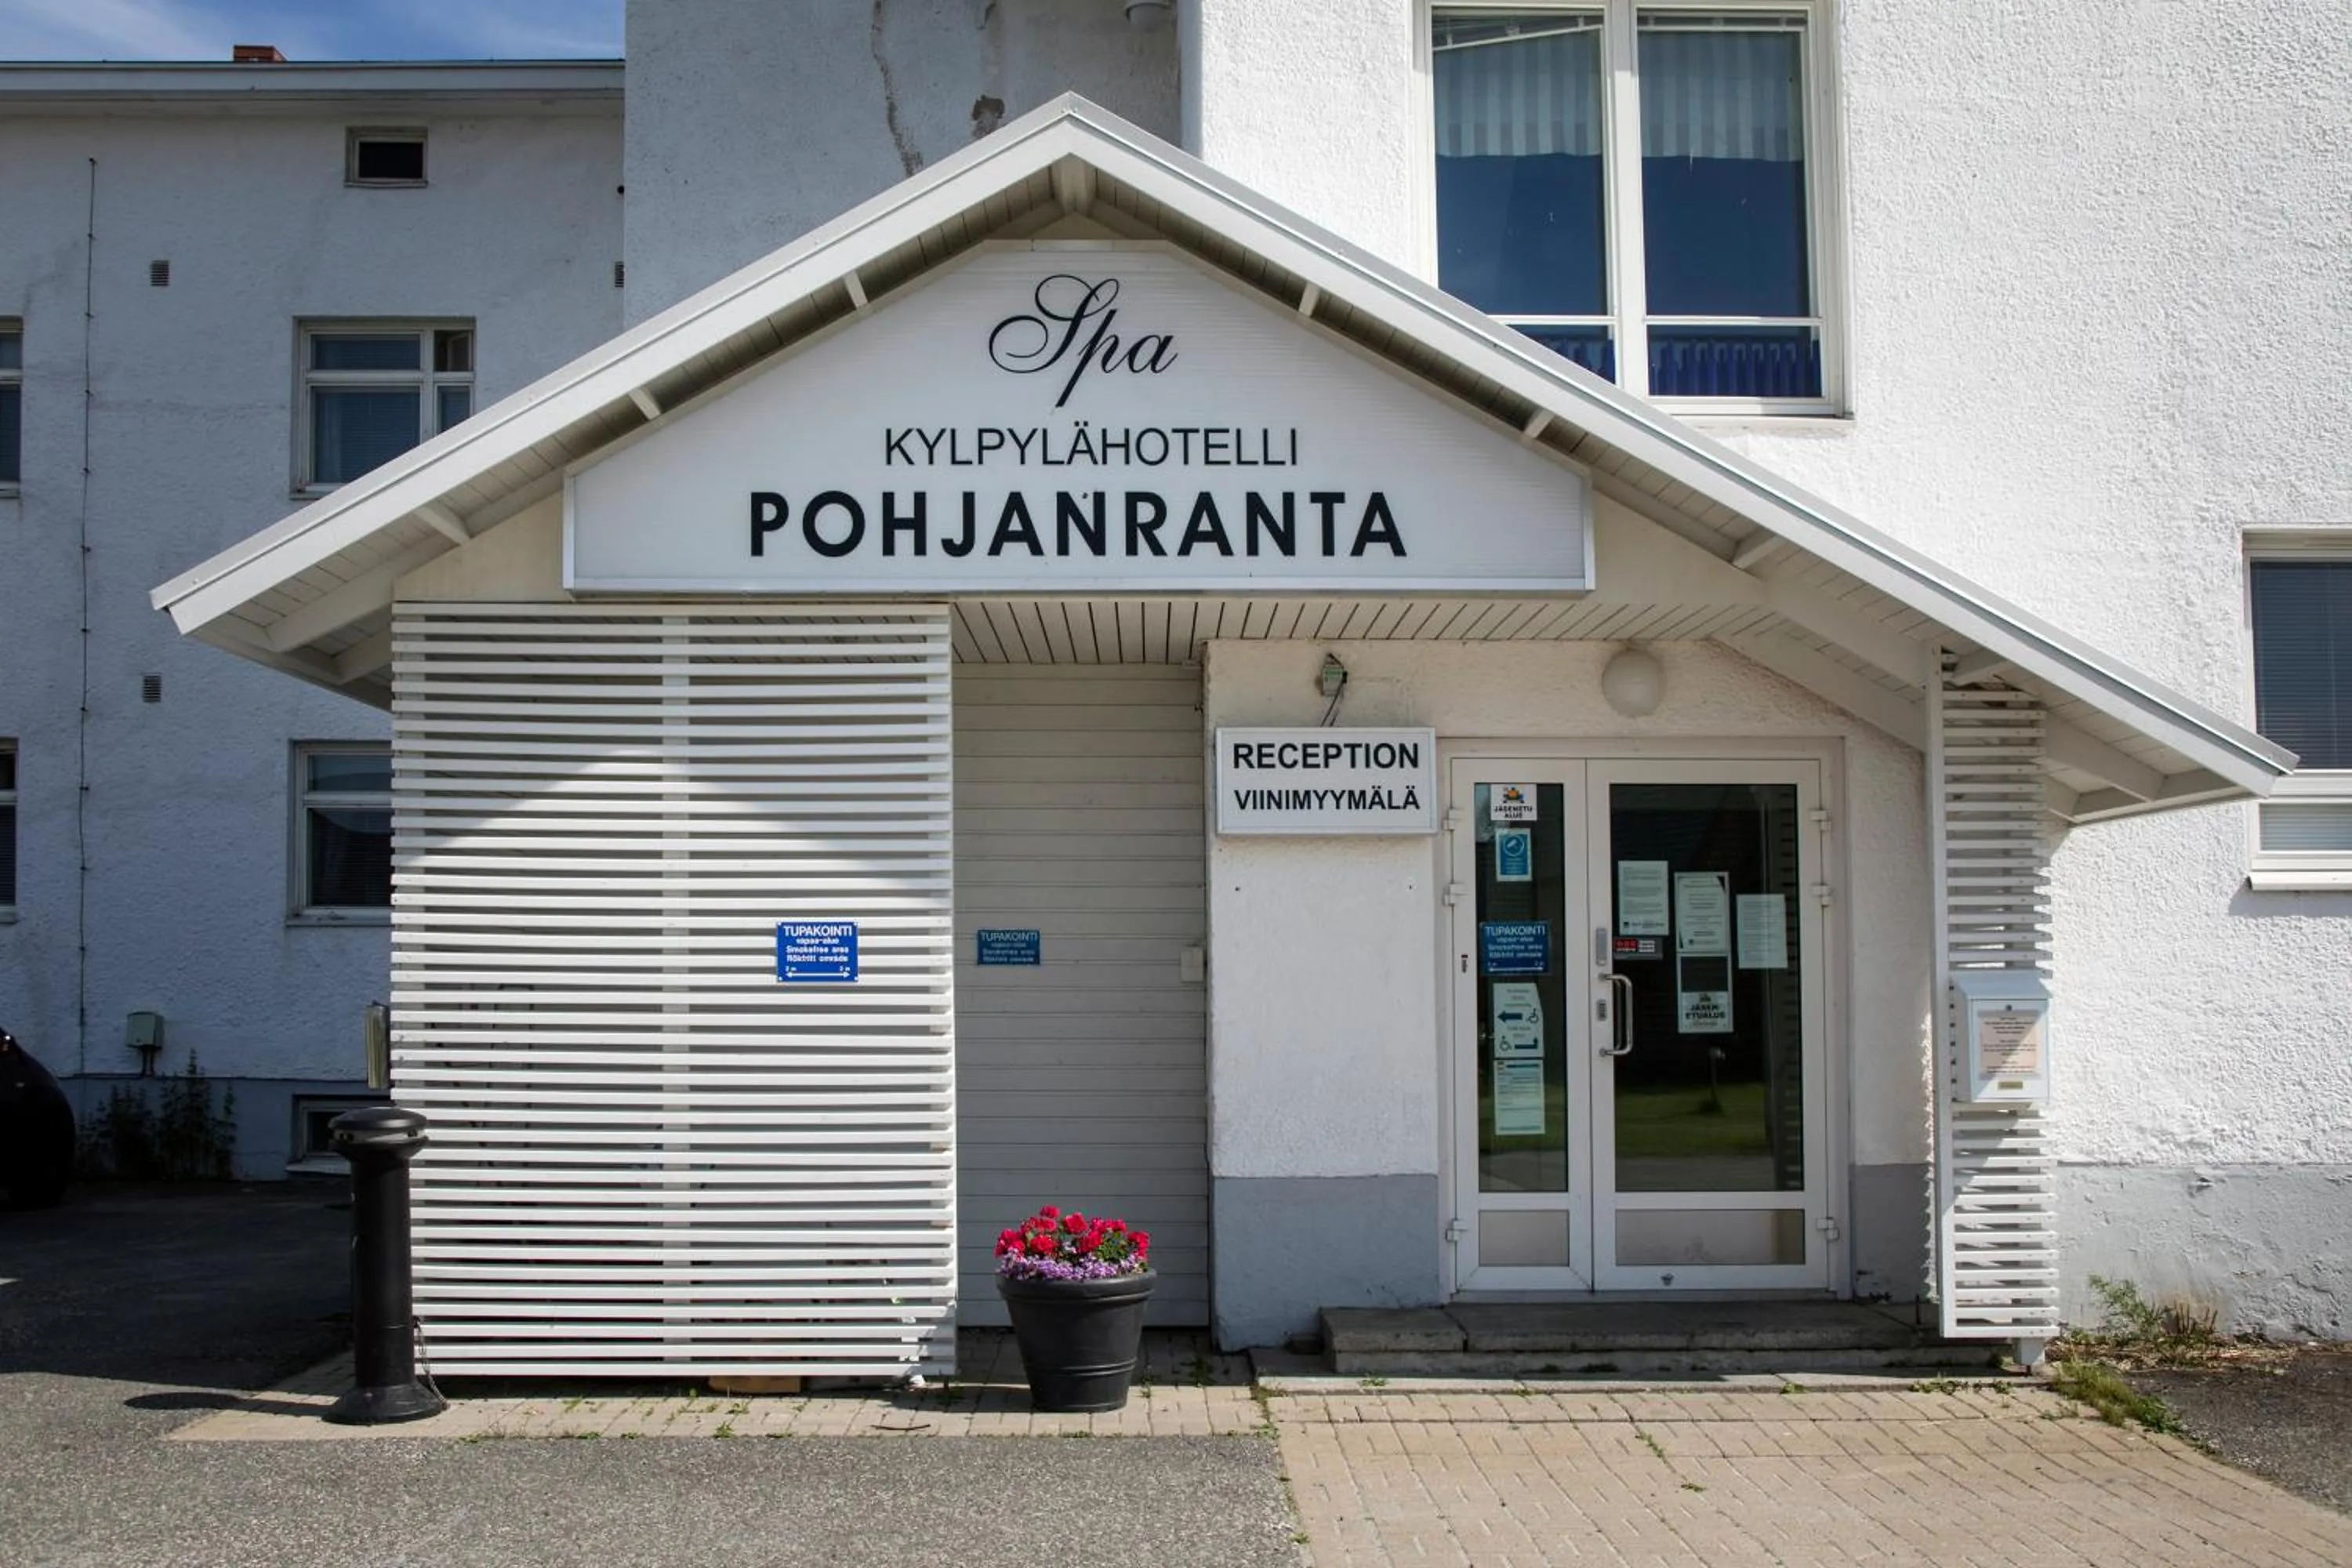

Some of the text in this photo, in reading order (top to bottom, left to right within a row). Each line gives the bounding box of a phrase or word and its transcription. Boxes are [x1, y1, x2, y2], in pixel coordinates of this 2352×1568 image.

[989, 274, 1178, 408] Spa
[886, 421, 1298, 466] KYLPYLÄHOTELLI
[750, 490, 1407, 557] POHJANRANTA
[1233, 742, 1419, 769] RECEPTION
[1234, 785, 1421, 810] VIINIMYYMÄLÄ
[784, 925, 852, 937] TUPAKOINTI
